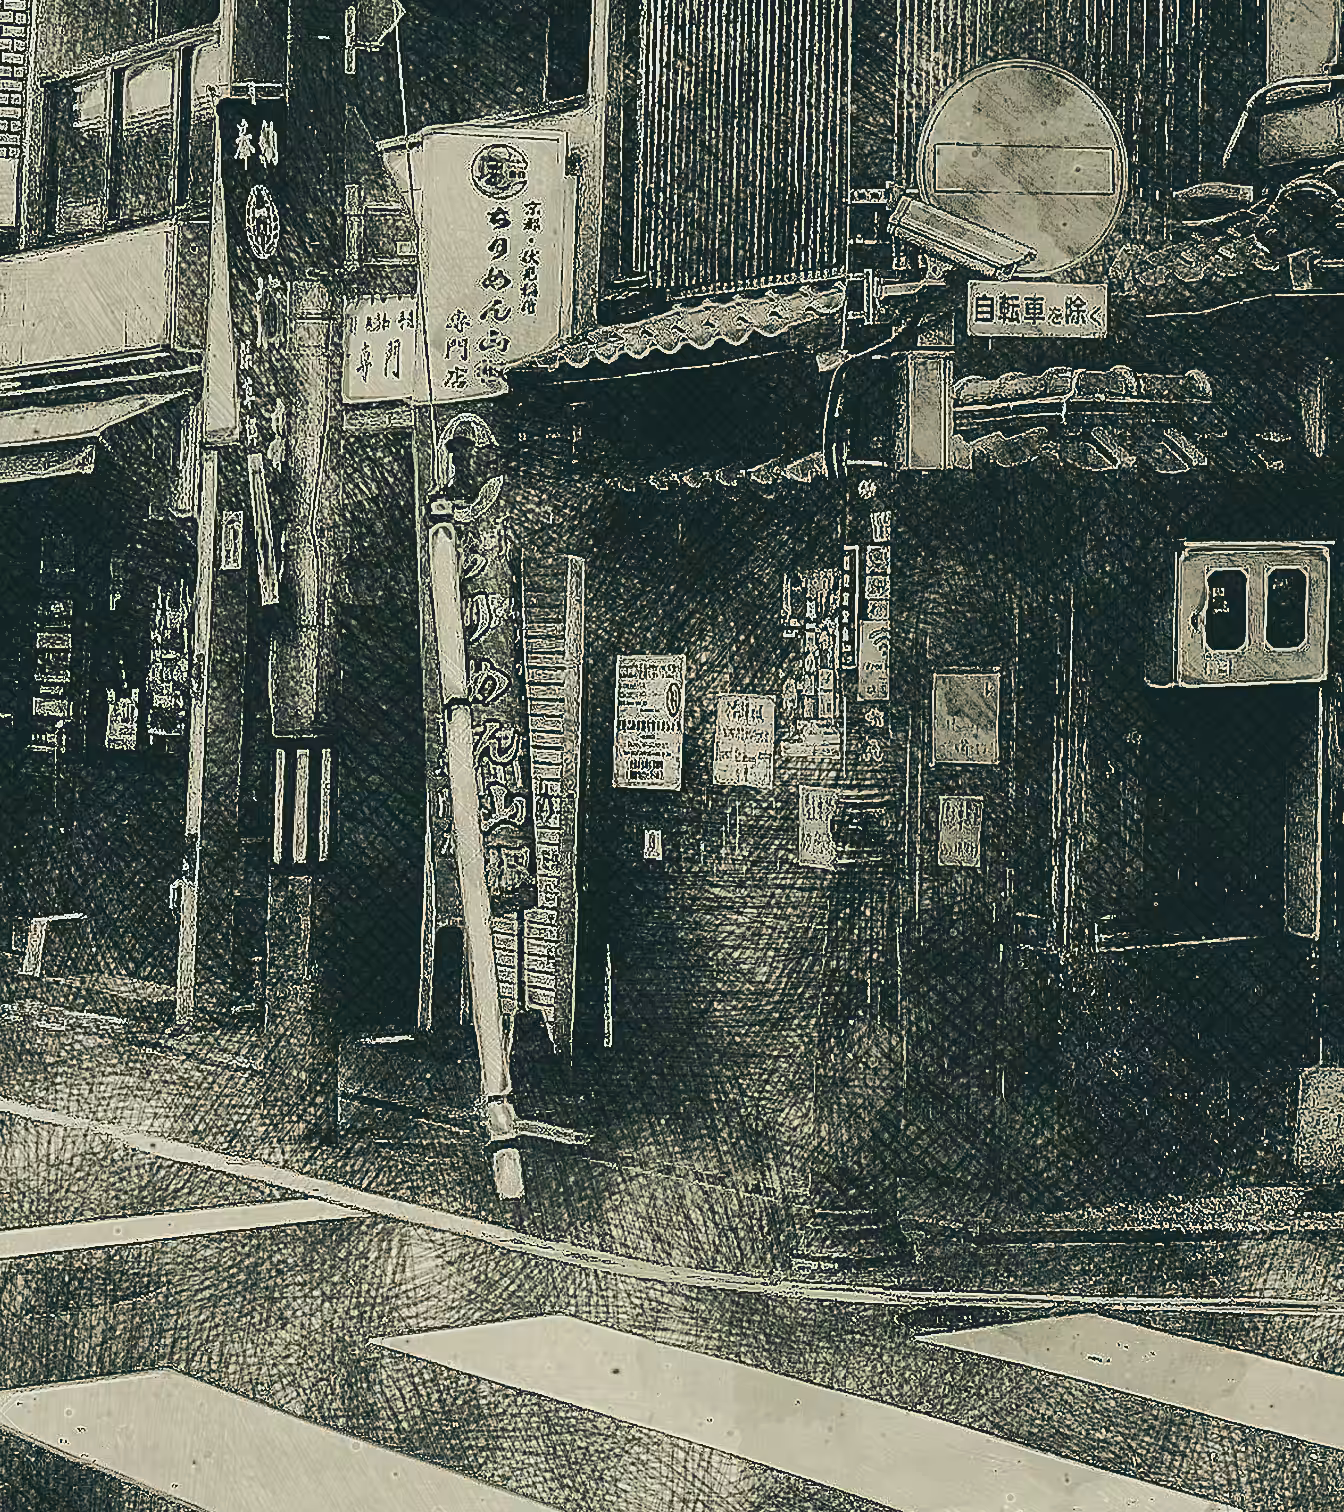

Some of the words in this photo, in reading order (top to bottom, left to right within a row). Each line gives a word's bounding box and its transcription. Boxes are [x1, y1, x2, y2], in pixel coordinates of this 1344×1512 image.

[975, 292, 1102, 326] 自転車を除く
